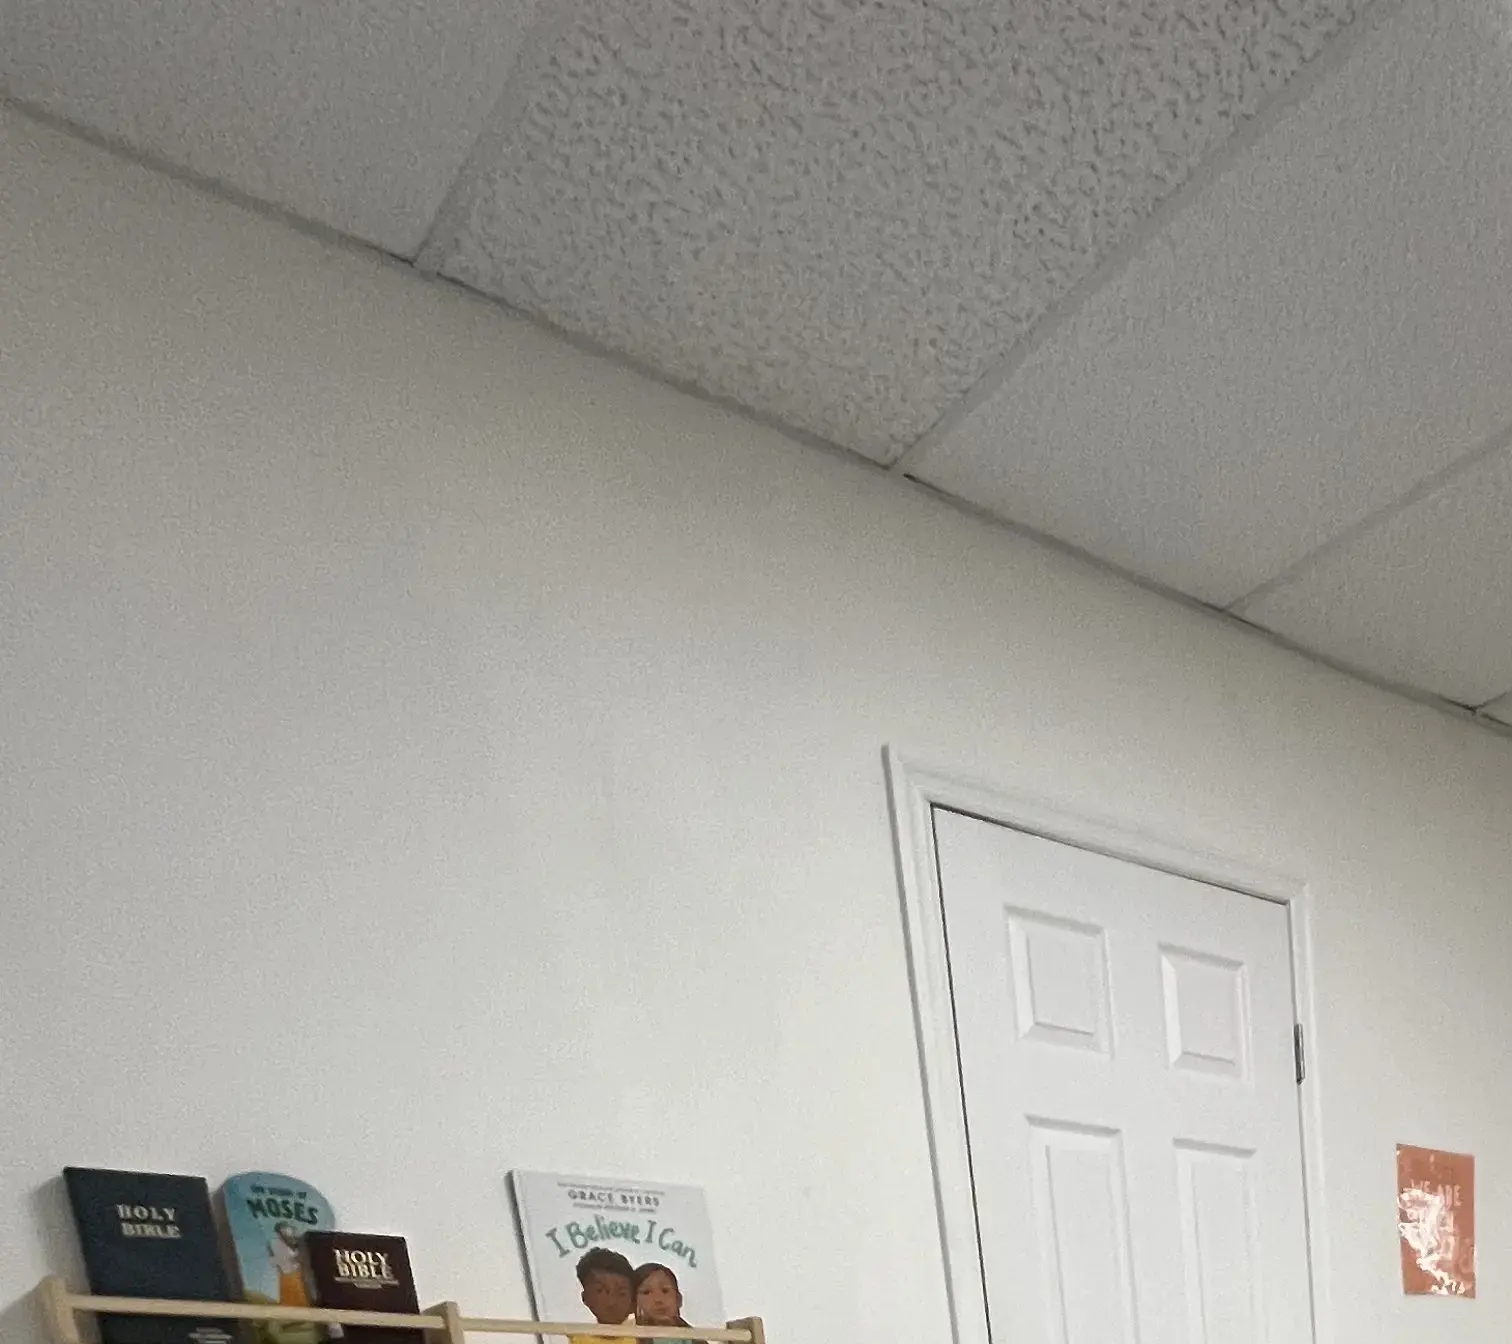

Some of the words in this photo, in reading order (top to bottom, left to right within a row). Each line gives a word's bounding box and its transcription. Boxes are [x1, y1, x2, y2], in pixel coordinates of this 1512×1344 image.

[116, 1204, 175, 1221] HOLY
[246, 1198, 318, 1225] MOSES
[121, 1223, 181, 1238] BIBLE
[545, 1227, 570, 1258] I
[566, 1214, 640, 1249] Believe
[644, 1219, 657, 1244] I
[658, 1227, 697, 1268] Can
[333, 1249, 388, 1266] HOLY
[338, 1263, 394, 1279] BIBLE
